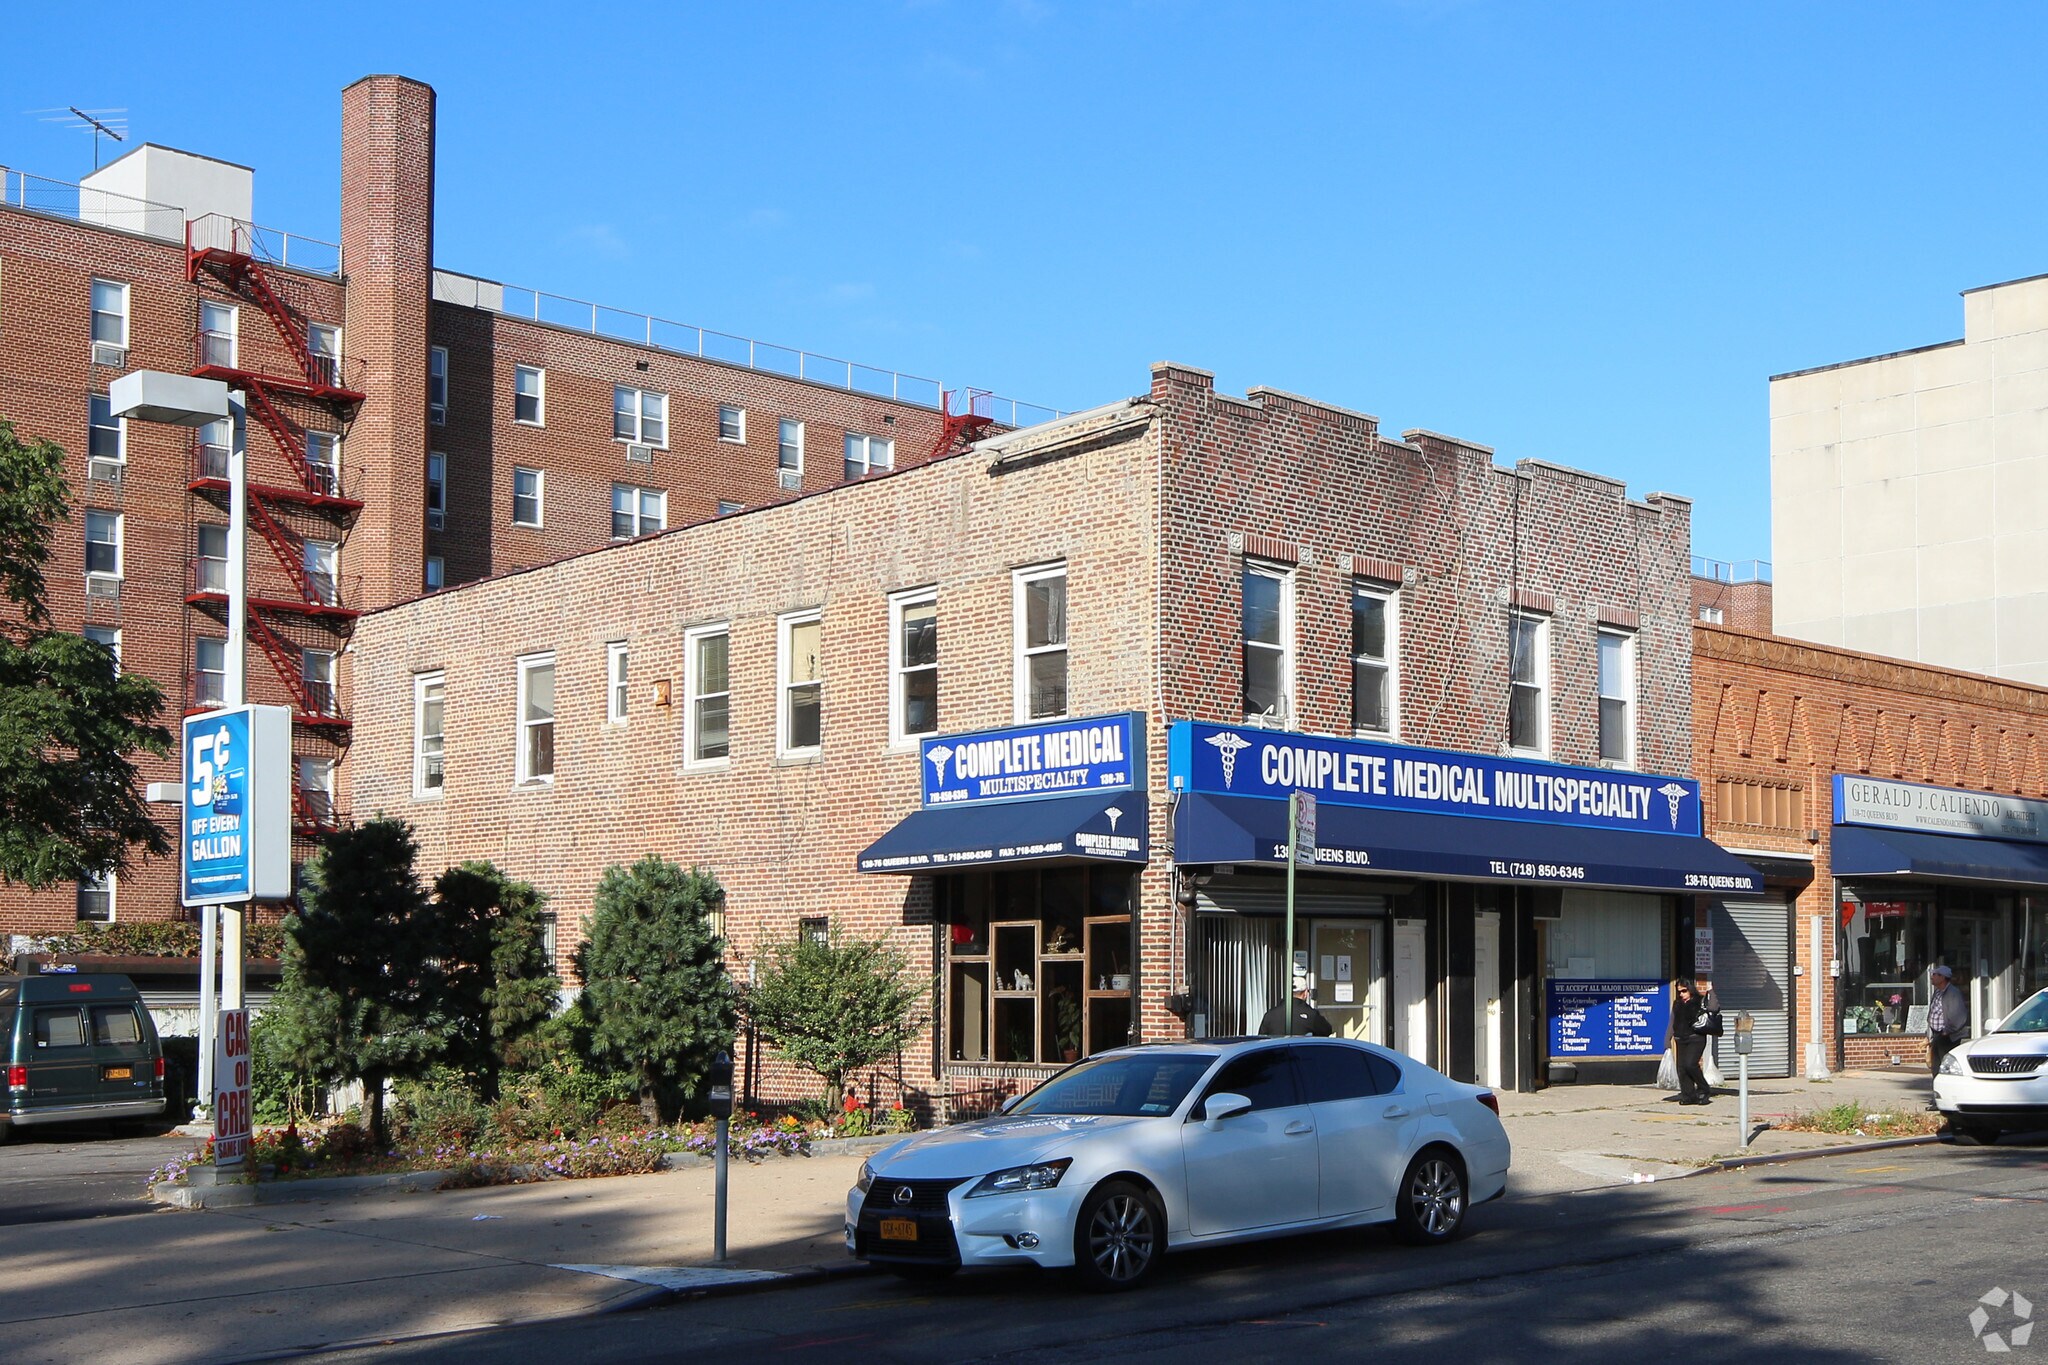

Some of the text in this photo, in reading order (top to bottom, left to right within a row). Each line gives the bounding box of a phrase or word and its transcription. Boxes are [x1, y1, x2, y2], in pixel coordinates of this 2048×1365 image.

[955, 725, 1124, 780] COMPLETE MEDICAL
[979, 768, 1090, 796] MULTISPECIALTY
[1100, 772, 1125, 785] 138-76
[1262, 745, 1652, 820] COMPLETE MEDICAL MULTISPECIALTY
[1851, 783, 1912, 808] GERALD
[1866, 809, 1885, 821] QUEENS
[1886, 812, 1899, 821] BLVD
[2006, 809, 2036, 823] ARCHITECT
[192, 814, 240, 836] OFF EVERY
[192, 834, 241, 862] GALLON
[1076, 832, 1140, 852] COMPLETE MEDICAL
[1085, 846, 1128, 857] MULTISPECIALTY
[861, 849, 993, 869] 138-76 QUEENS BLVD. TEL: 718-850-6345
[999, 847, 1015, 857] FAX:
[1315, 847, 1344, 862] UEENS
[1345, 850, 1371, 866] BLVD.
[1489, 861, 1585, 880] TEL (718) 850-6345
[1685, 873, 1753, 889] 138-76 QUEENS BLVD.
[1555, 984, 1659, 993] WE ACCEPT ALL MAJOR INSURANCES
[1633, 1004, 1652, 1013] Therapy
[225, 1011, 249, 1058] CAS
